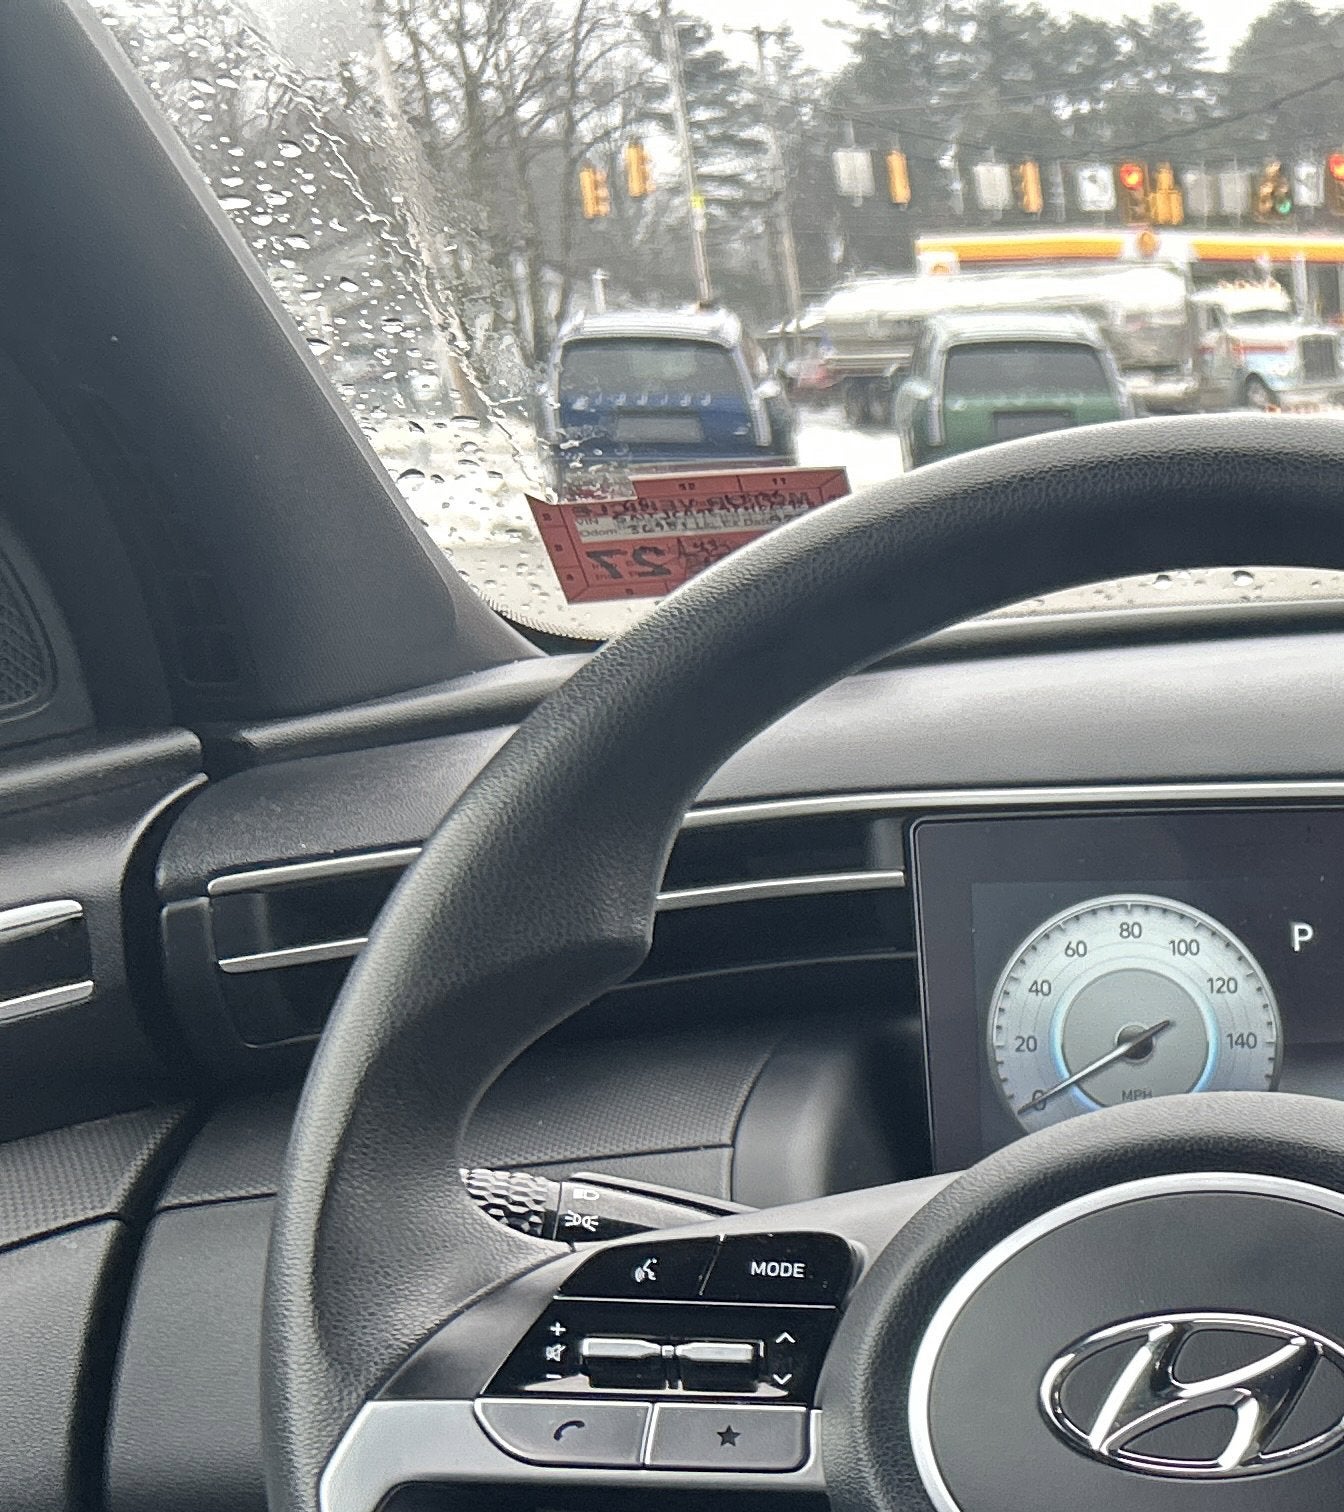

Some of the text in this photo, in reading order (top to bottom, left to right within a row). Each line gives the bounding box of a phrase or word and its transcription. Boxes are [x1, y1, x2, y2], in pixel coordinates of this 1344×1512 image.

[1119, 922, 1143, 939] 80
[1291, 922, 1314, 952] P
[1064, 940, 1088, 958] 60
[1169, 939, 1200, 957] 100
[1028, 980, 1052, 996] 40
[1207, 977, 1238, 994] 120
[1015, 1036, 1038, 1052] 20
[1226, 1032, 1257, 1050] 140
[1121, 1088, 1153, 1101] MPH
[750, 1260, 806, 1279] MODE
